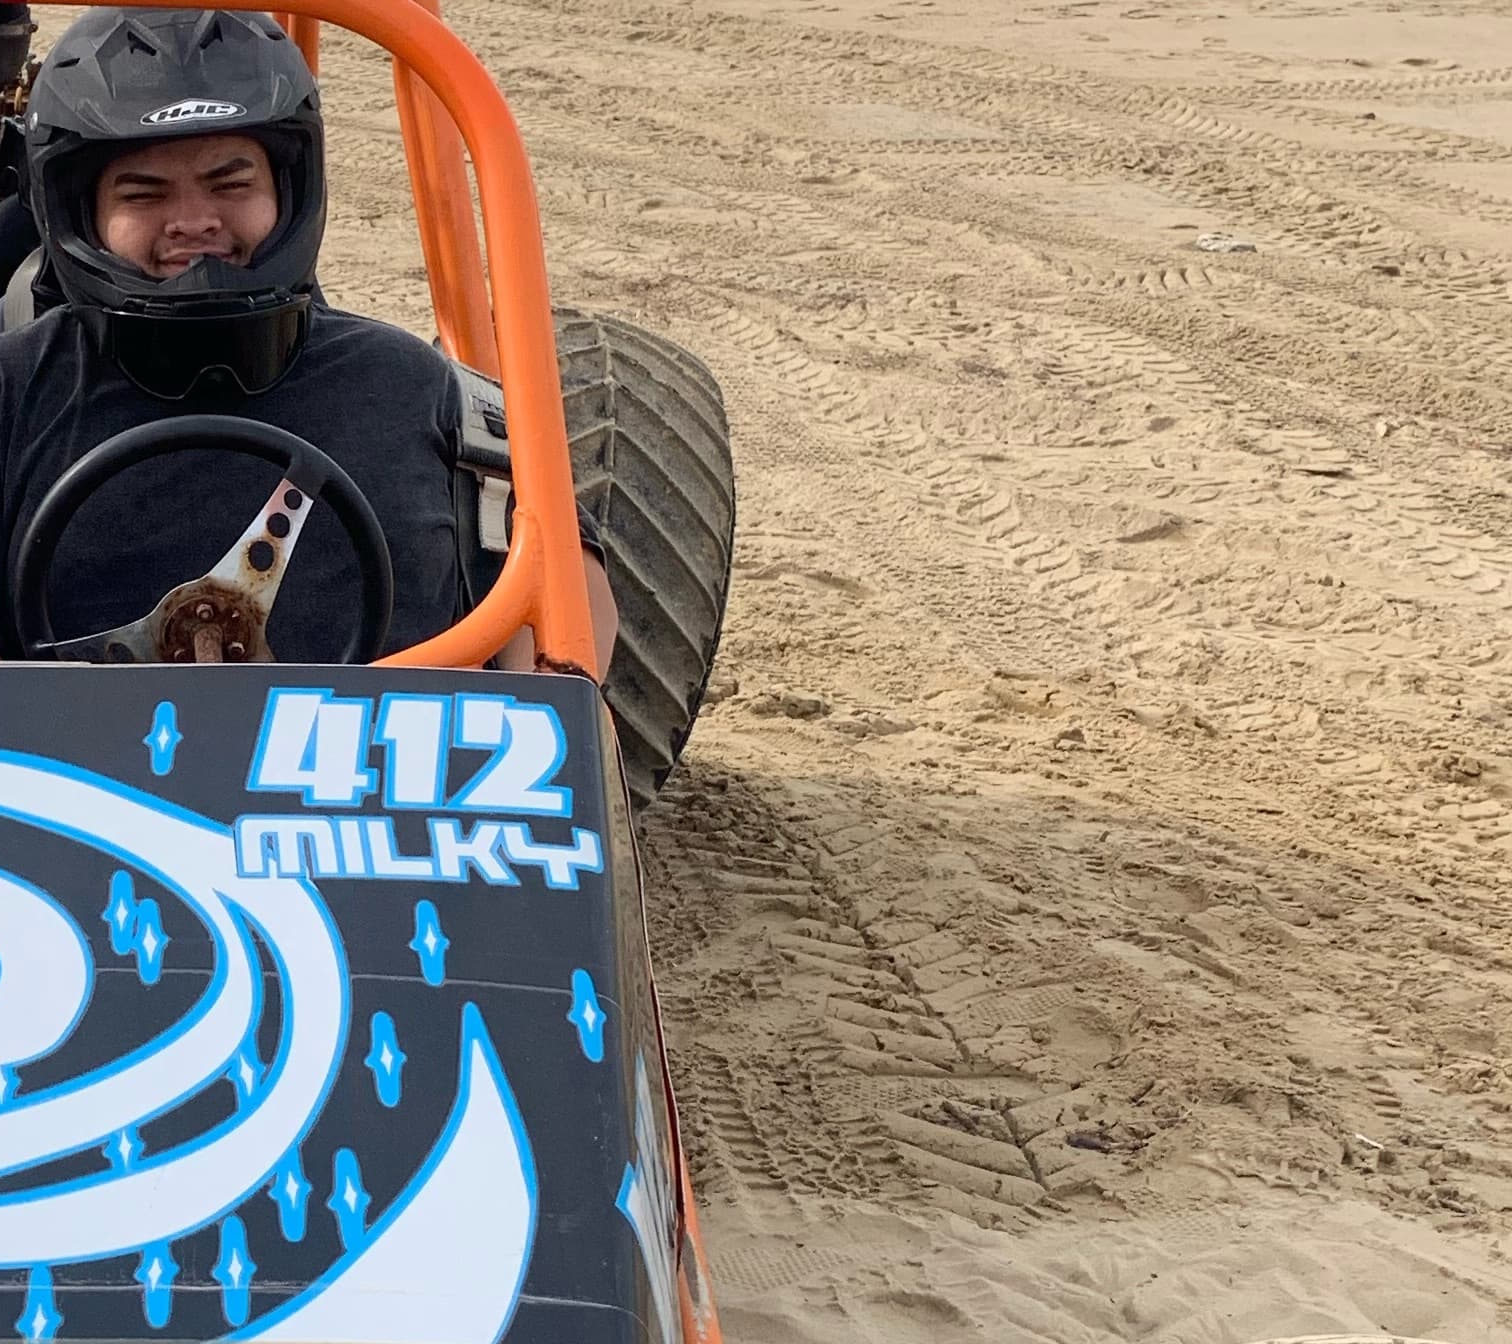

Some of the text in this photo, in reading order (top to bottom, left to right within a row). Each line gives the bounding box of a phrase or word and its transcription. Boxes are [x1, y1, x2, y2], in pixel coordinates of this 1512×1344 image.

[156, 104, 231, 122] HJC
[247, 688, 572, 818] 412
[235, 815, 605, 890] MILKY
